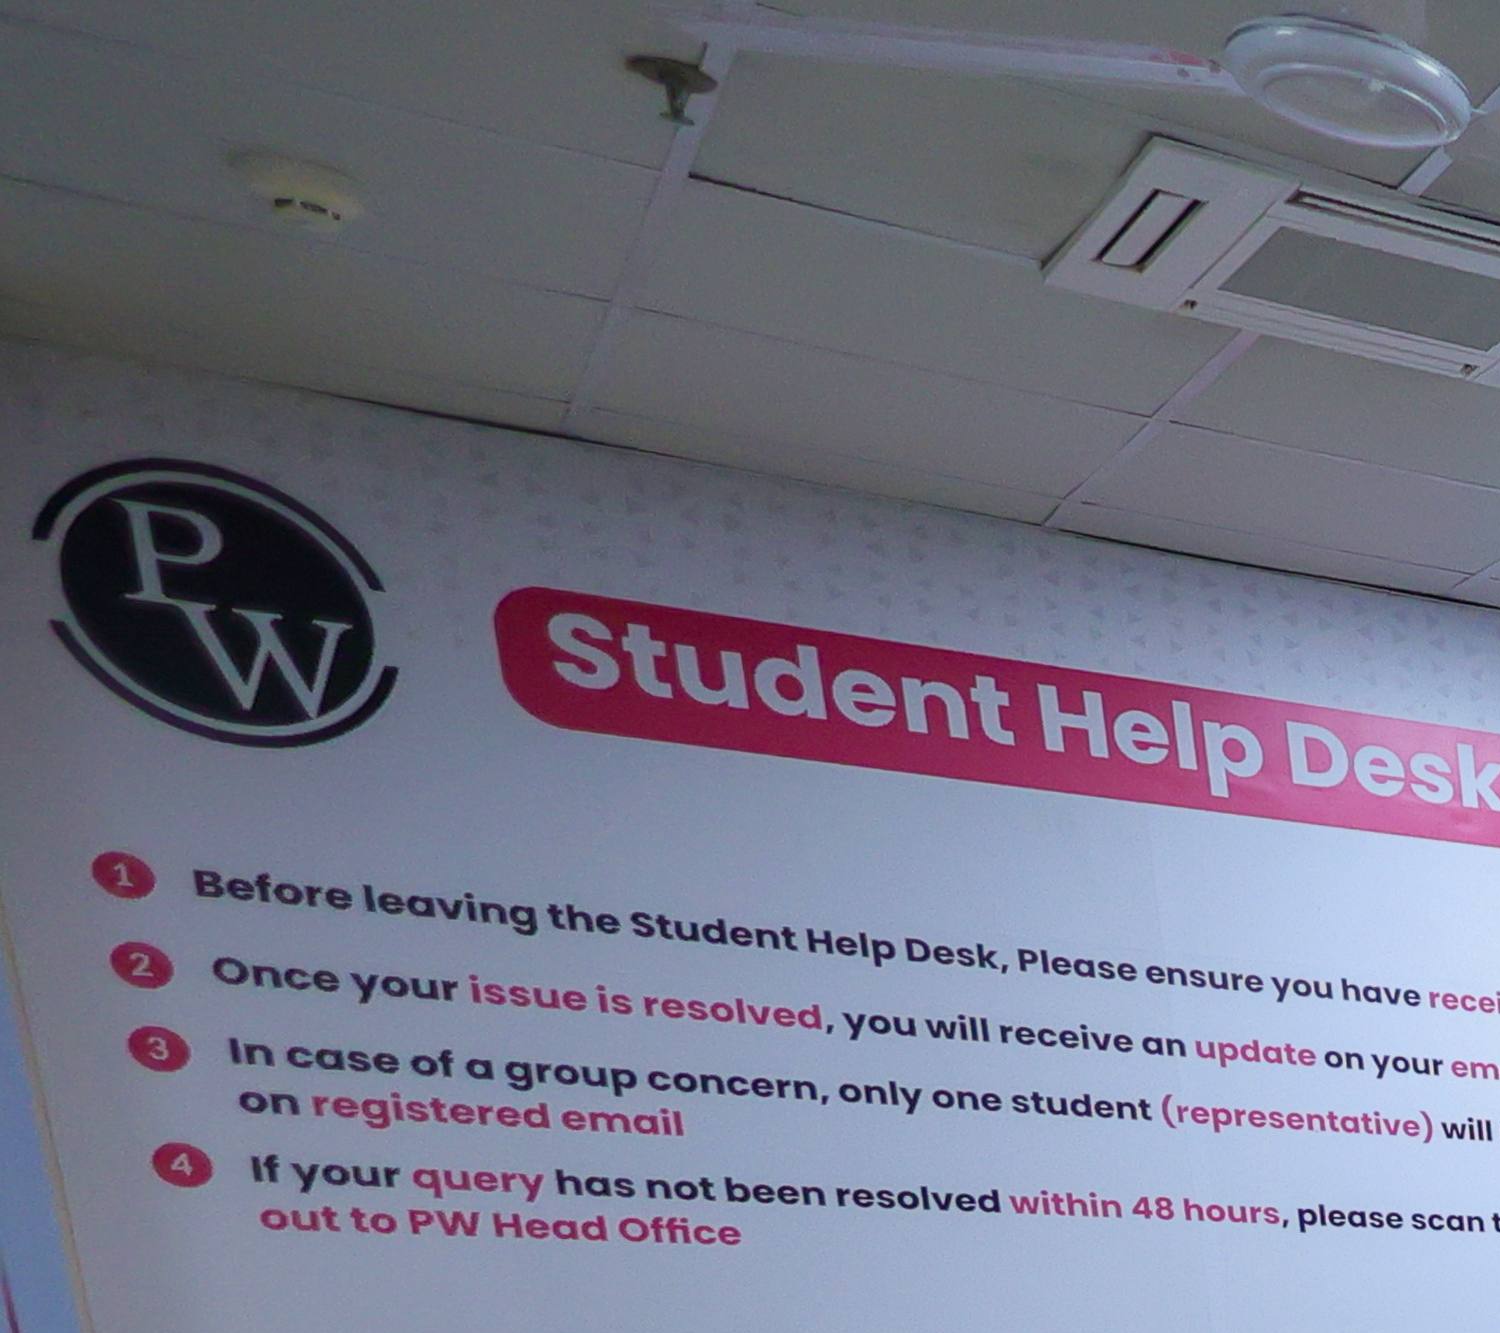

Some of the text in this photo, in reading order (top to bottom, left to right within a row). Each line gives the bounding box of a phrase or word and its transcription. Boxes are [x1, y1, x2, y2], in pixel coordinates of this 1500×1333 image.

[545, 610, 1014, 748] Student
[1039, 684, 1263, 798] Help
[192, 868, 353, 911] Before
[362, 883, 539, 937] leaving
[546, 903, 622, 935] the
[629, 911, 799, 952] Student
[805, 927, 897, 968] Help
[903, 937, 1009, 975] Desk,
[1016, 947, 1138, 982] Please
[1145, 964, 1265, 994] ensure
[1269, 976, 1334, 1004] you
[1340, 977, 1422, 1008] have
[211, 956, 341, 993] Once
[349, 972, 459, 1005] your
[468, 973, 588, 1012] issue
[595, 984, 633, 1016] is
[642, 996, 835, 1035] resolved,
[841, 1011, 918, 1042] you
[923, 1013, 991, 1043] will
[998, 1023, 1134, 1054] receive
[1141, 1035, 1187, 1058] an
[1194, 1039, 1317, 1069] update
[1323, 1050, 1366, 1071] on
[1370, 1053, 1445, 1080] your
[227, 1037, 276, 1067] In
[285, 1046, 401, 1075] case
[409, 1048, 455, 1078] of
[464, 1058, 495, 1081] a
[504, 1060, 638, 1098] group
[646, 1070, 830, 1106] concern,
[837, 1080, 923, 1116] only
[931, 1088, 1003, 1112] one
[1010, 1090, 1153, 1122] student
[1161, 1093, 1434, 1145] (representative)
[1440, 1116, 1494, 1143] will
[238, 1090, 685, 1137] on registered email
[250, 1153, 281, 1184] If
[289, 1162, 401, 1195] your
[411, 1168, 545, 1203] query
[554, 1168, 637, 1199] has
[645, 1176, 717, 1202] not
[723, 1176, 827, 1207] been
[835, 1185, 1002, 1214] resolved
[1008, 1189, 1123, 1219] within
[1131, 1196, 1175, 1221] 48
[1182, 1197, 1290, 1230] hours,
[1296, 1203, 1404, 1234] please
[1410, 1212, 1486, 1233] scan
[259, 1205, 742, 1246] out to PW Head Office
